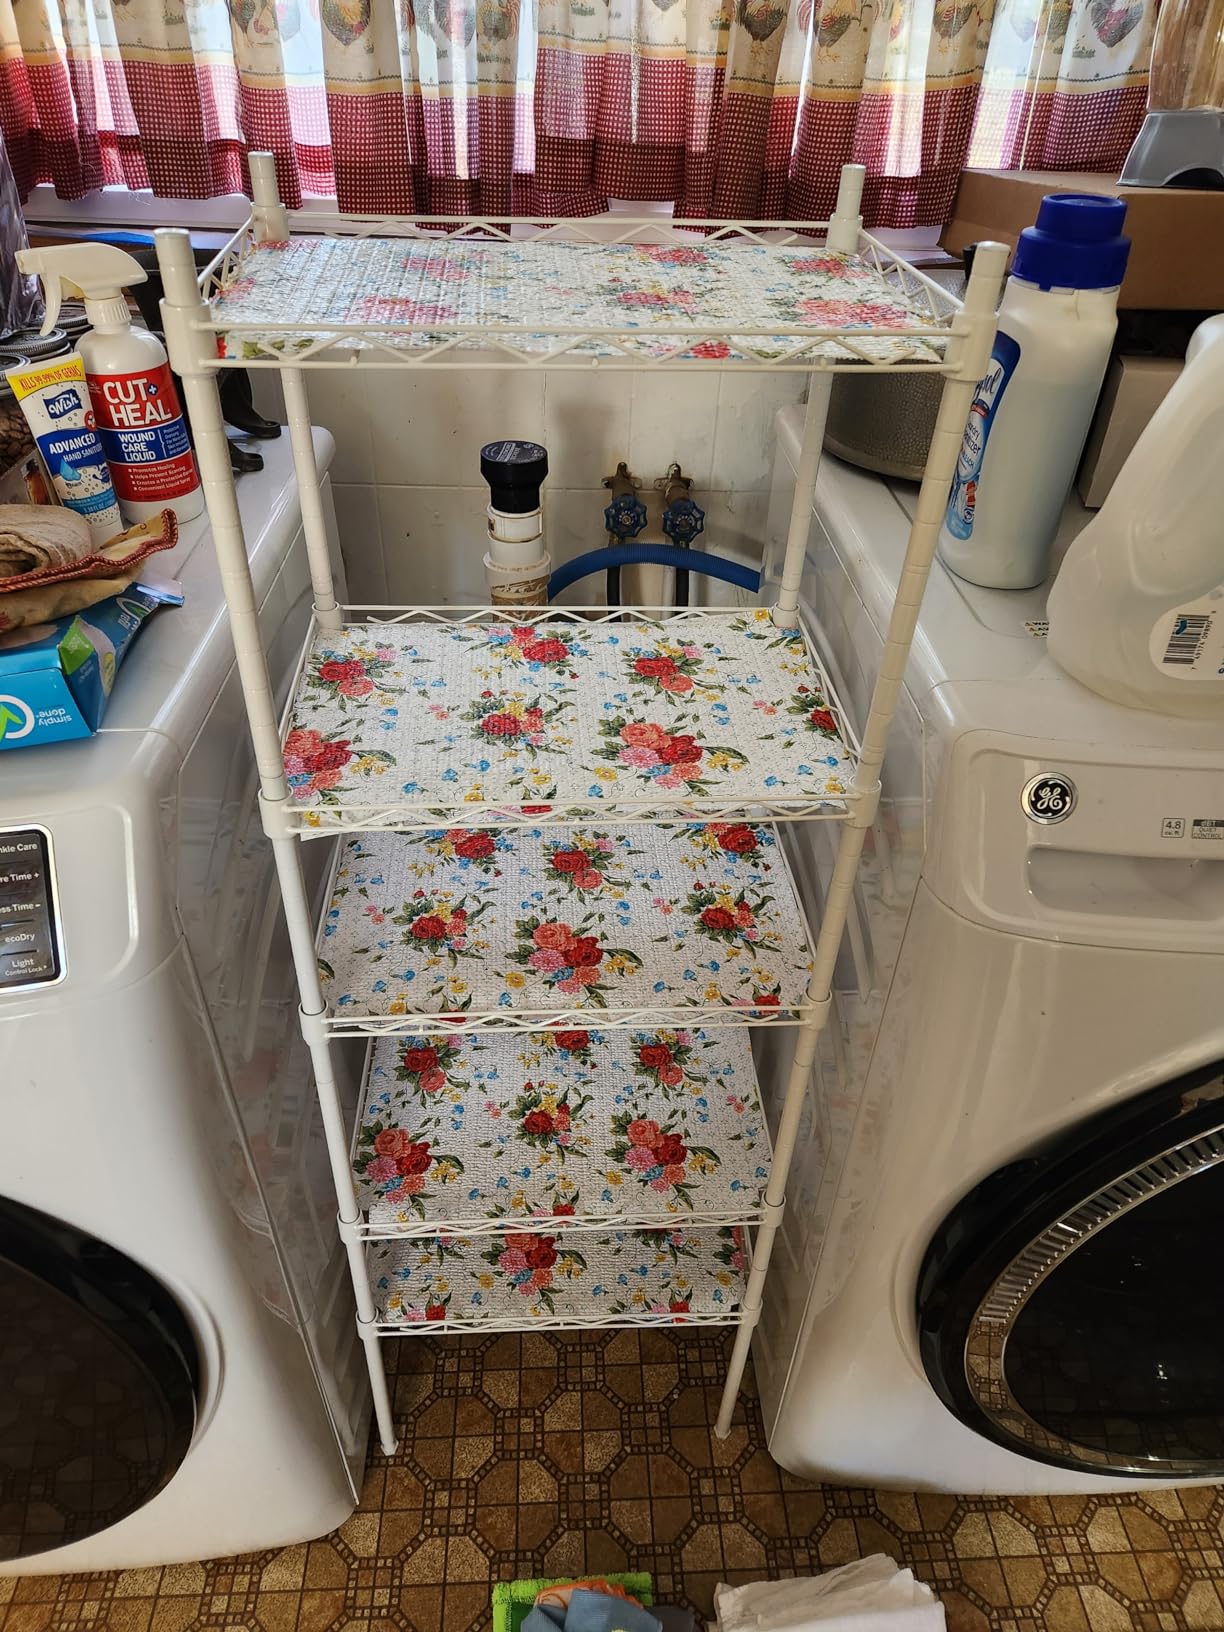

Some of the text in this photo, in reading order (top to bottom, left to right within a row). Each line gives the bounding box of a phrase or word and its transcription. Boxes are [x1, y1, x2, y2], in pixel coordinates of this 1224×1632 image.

[20, 375, 37, 391] KILLS
[61, 365, 81, 380] GERMS
[103, 378, 148, 404] CUT
[48, 393, 79, 415] Wish
[109, 399, 172, 427] HEAL
[118, 431, 156, 443] WOUND
[49, 432, 96, 455] ADVANCED
[121, 442, 148, 452] CARE
[63, 451, 82, 463] HAND
[124, 451, 156, 462] LIQUID
[38, 708, 66, 718] done
[38, 715, 72, 726] simply
[1165, 820, 1182, 829] 4.8
[16, 843, 38, 852] Care
[9, 873, 32, 881] Time
[11, 903, 34, 912] Time
[5, 933, 35, 943] ecoDry
[11, 958, 34, 969] Light
[5, 966, 43, 977] Control Lock
